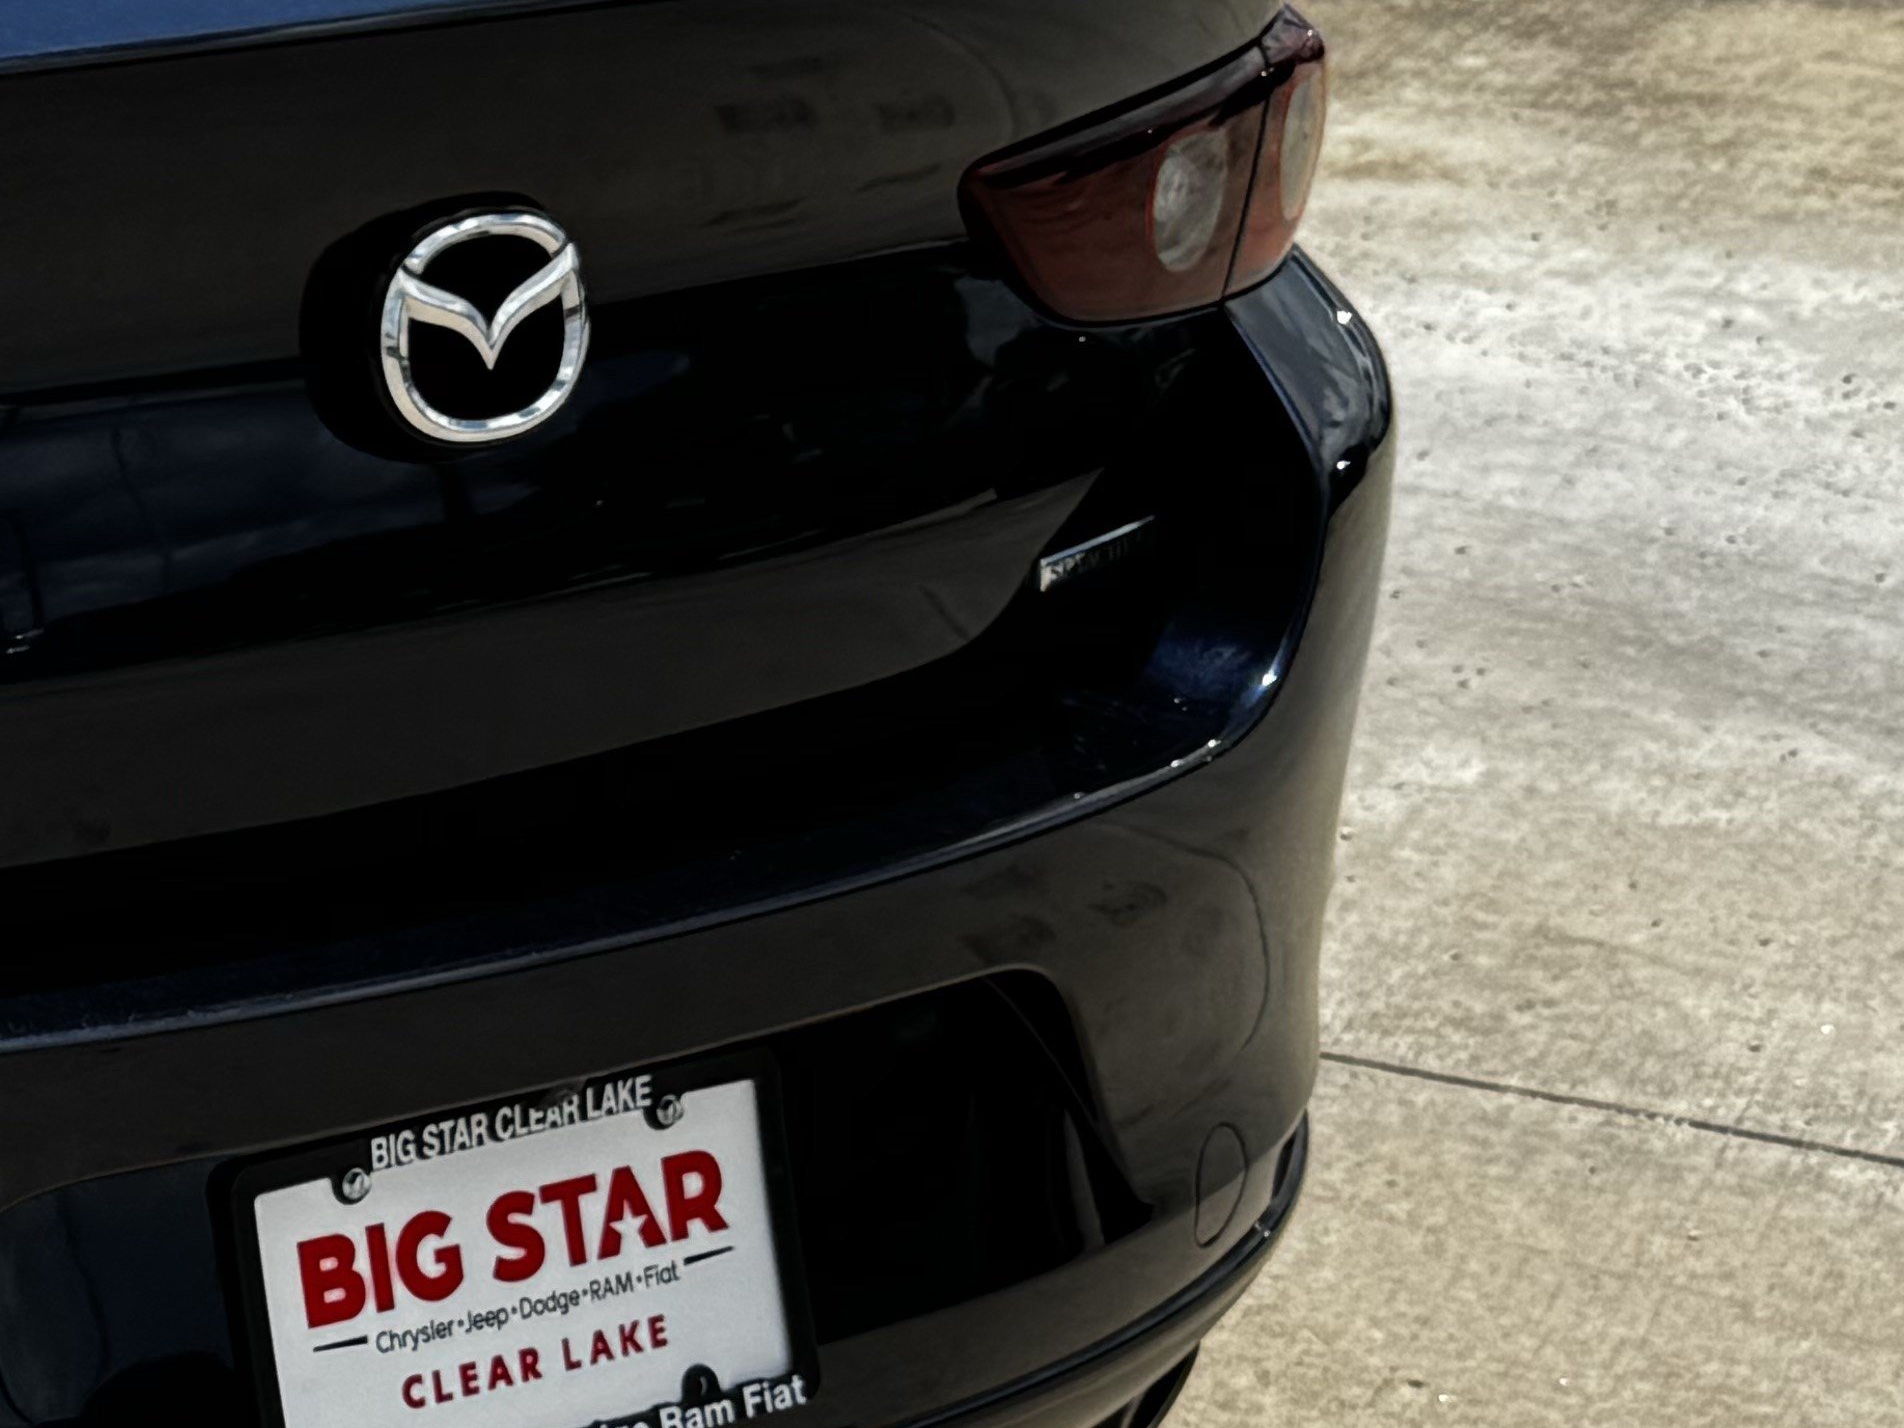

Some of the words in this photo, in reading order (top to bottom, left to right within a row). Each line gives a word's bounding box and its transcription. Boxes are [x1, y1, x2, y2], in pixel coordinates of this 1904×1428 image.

[371, 1129, 417, 1171] BIG
[421, 1112, 489, 1159] STAR
[494, 1094, 580, 1141] CLEAR
[585, 1074, 652, 1120] LAKE
[295, 1208, 465, 1329] BIG
[485, 1148, 731, 1283] STAR
[401, 1346, 544, 1410] CLEAR
[560, 1313, 670, 1372] LAKE
[742, 1373, 808, 1419] Fiat
